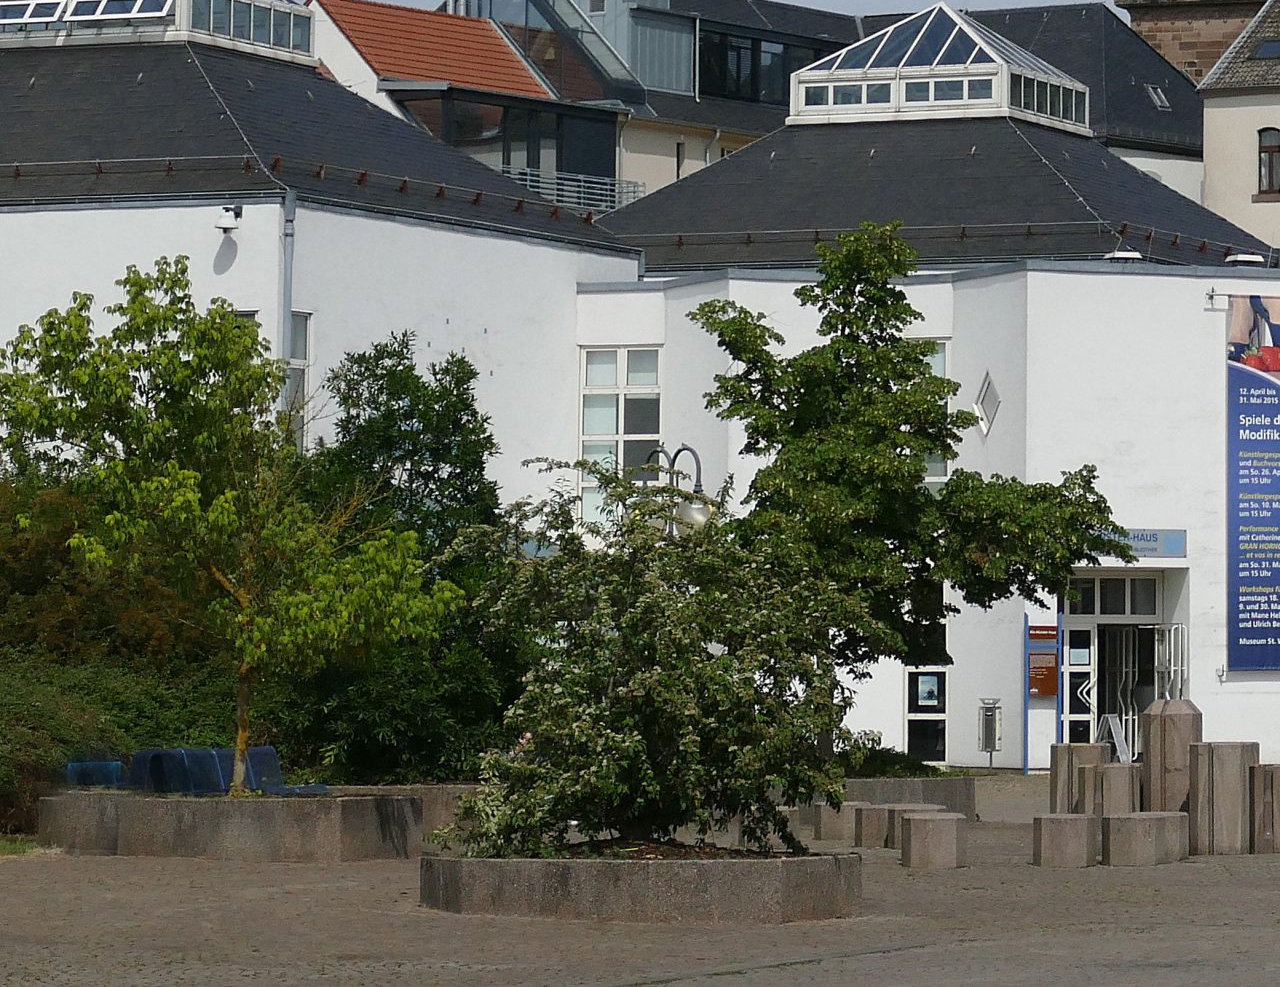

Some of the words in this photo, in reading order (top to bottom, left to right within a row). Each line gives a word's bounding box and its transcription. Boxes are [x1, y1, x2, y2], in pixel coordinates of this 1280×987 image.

[1250, 388, 1265, 396] April
[1239, 414, 1271, 427] Spiele
[1267, 551, 1273, 559] in
